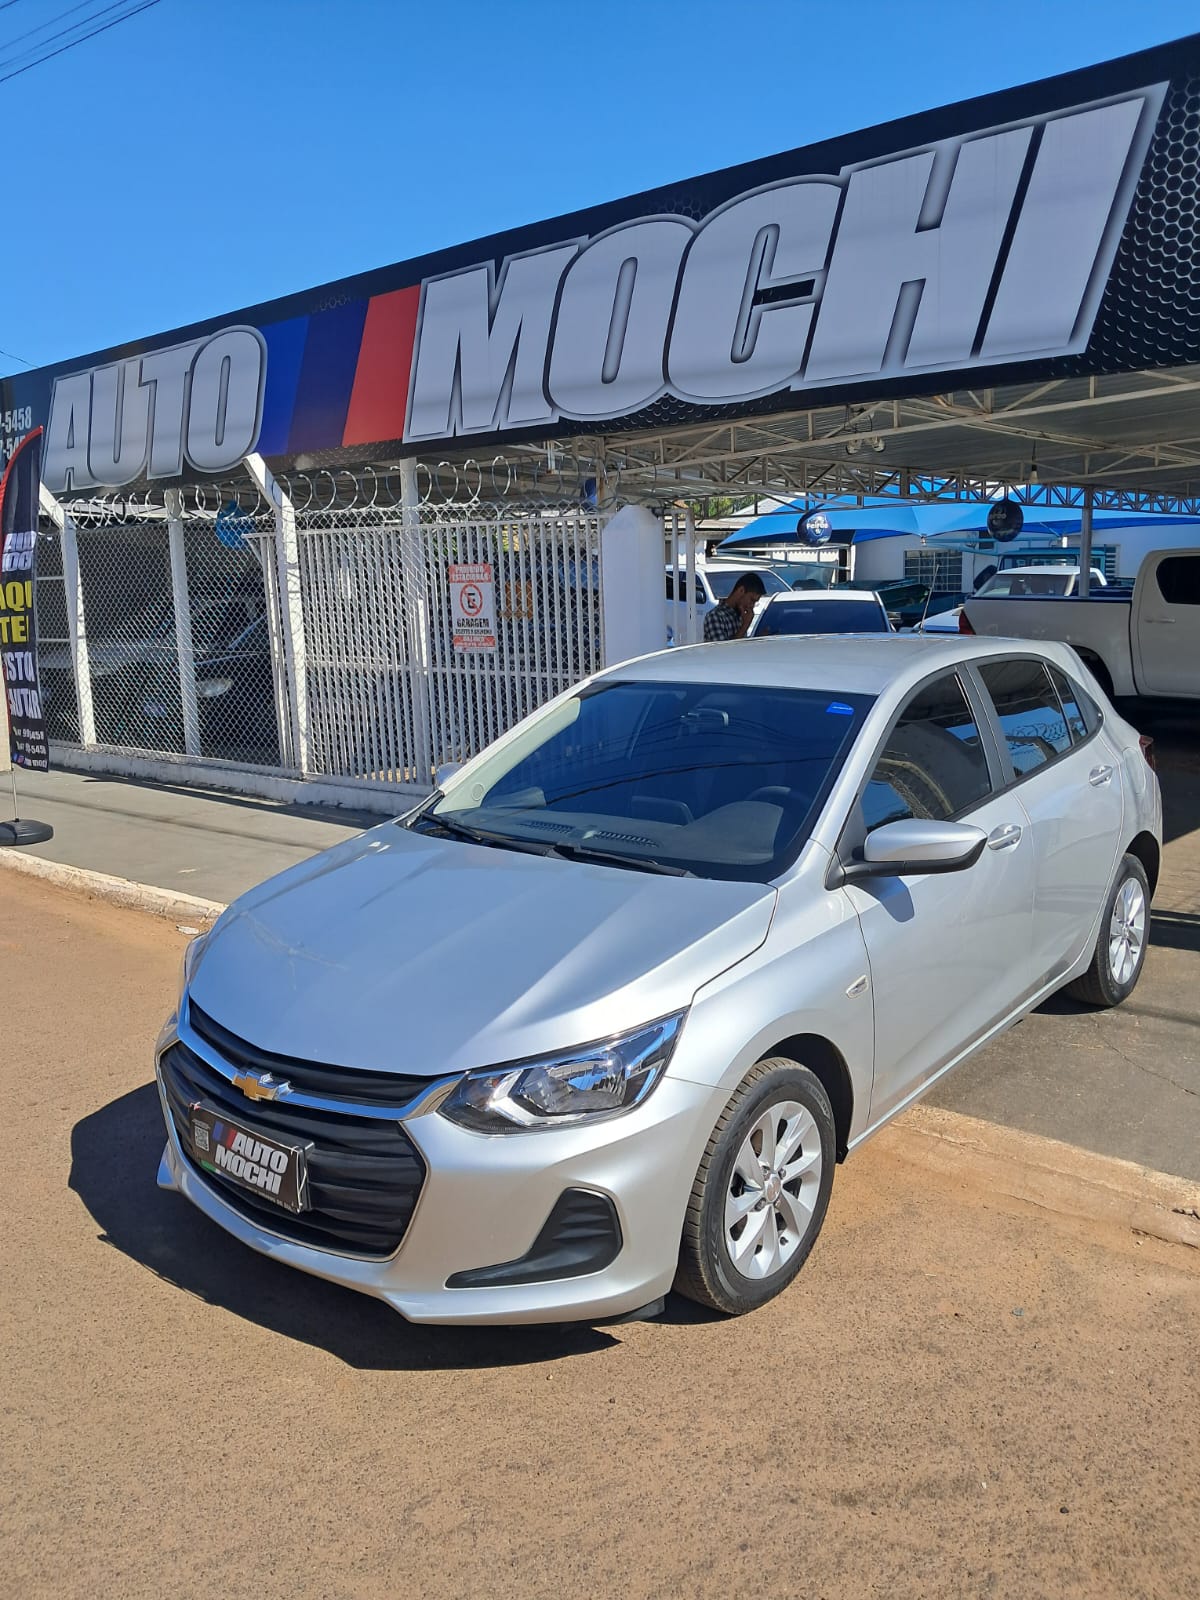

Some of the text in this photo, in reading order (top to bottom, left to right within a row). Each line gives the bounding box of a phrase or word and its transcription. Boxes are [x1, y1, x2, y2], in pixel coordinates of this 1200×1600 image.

[41, 81, 1169, 492] AUTO MOCHI
[457, 618, 489, 628] GARAGEM
[214, 1143, 282, 1195] MOCHI
[231, 1131, 289, 1174] AUTO
